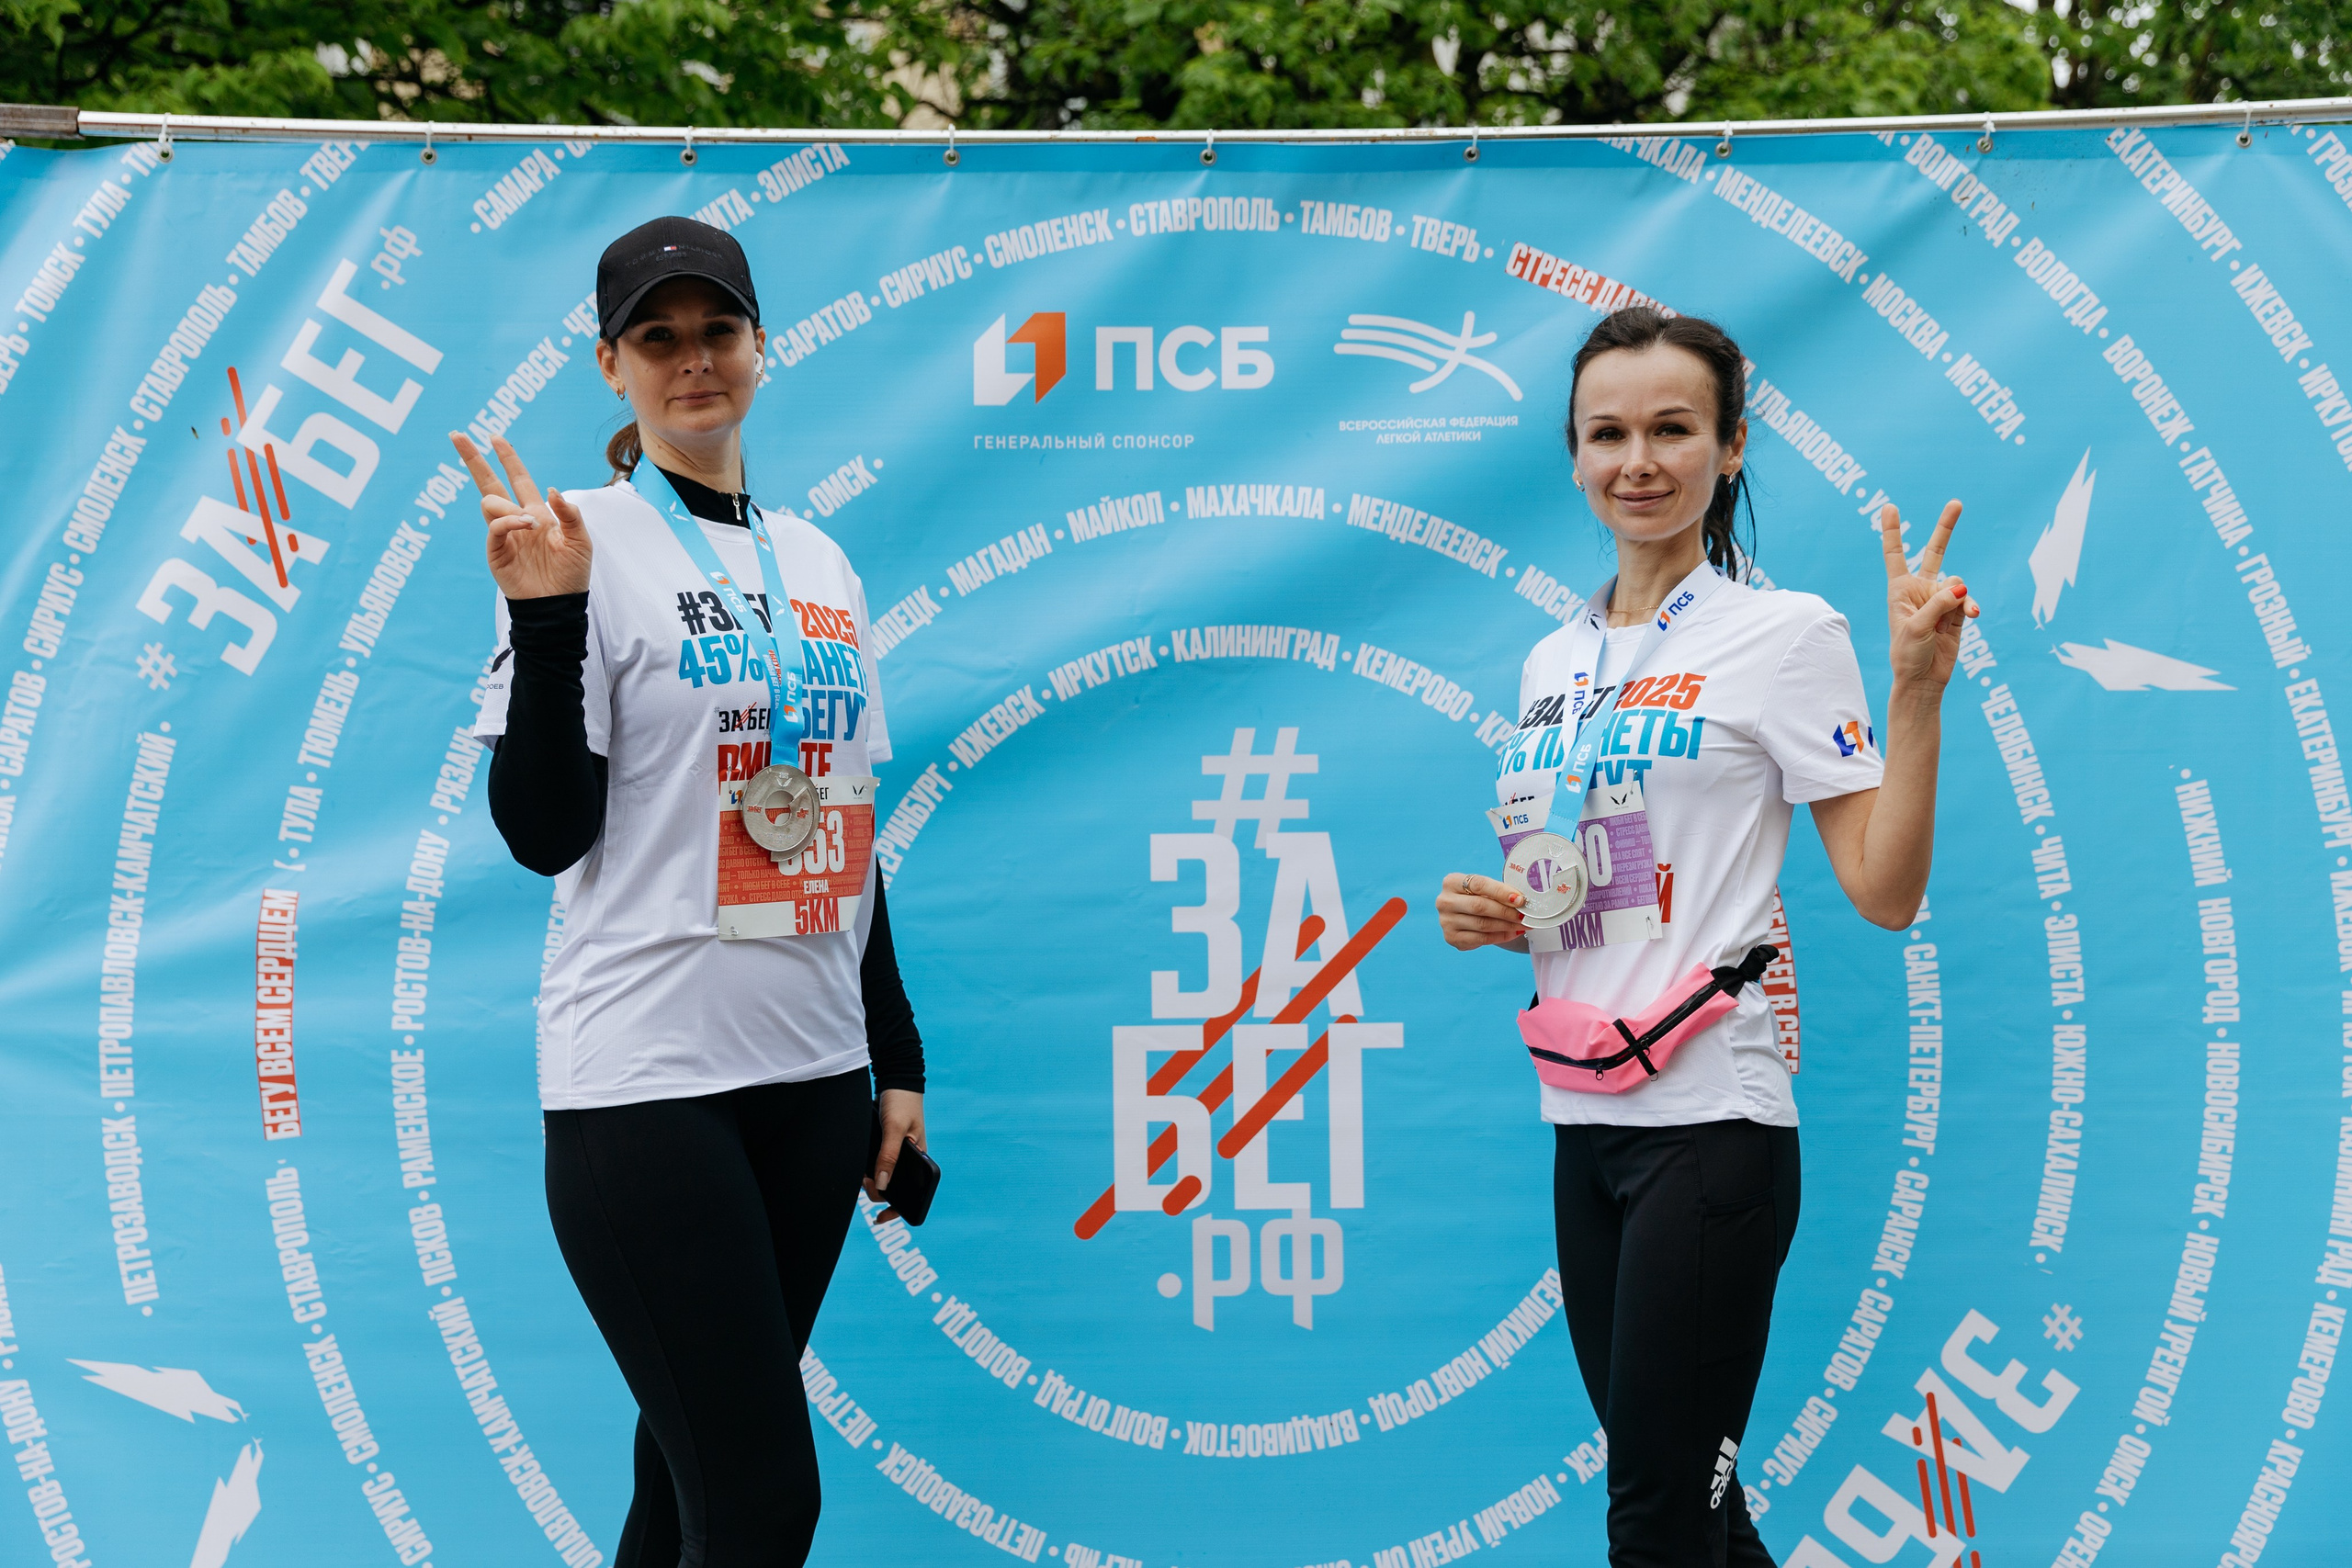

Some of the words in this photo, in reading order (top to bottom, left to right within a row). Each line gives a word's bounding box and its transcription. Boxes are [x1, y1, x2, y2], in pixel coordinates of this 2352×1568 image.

[472, 147, 561, 221] САМАРА
[757, 141, 851, 205] ЭЛИСТА
[14, 241, 86, 323] ТОМСК
[74, 173, 131, 239] ТУЛА
[225, 186, 308, 277] ТАМБОВ
[773, 291, 873, 367] САРАТОВ
[878, 245, 973, 309] СИРИУС
[984, 209, 1114, 268] СМОЛЕНСК
[1129, 197, 1280, 237] СТАВРОПОЛЬ
[1300, 200, 1392, 242] ТАМБОВ
[1410, 215, 1480, 263] ТВЕРЬ
[1506, 243, 1599, 304] СТРЕСС
[1713, 165, 1869, 284] МЕНДЕЛЕЕВСК
[1861, 273, 1950, 361] МОСКВА
[1944, 352, 2026, 442] МСТЁРА
[2230, 264, 2313, 364] ИЖЕВСК
[130, 282, 238, 423] СТАВРОПОЛЬ
[1095, 324, 1275, 392] ПСБ
[974, 432, 1105, 449] ГЕНЕРАЛЬНЫЙ
[1112, 434, 1194, 449] СПОНСОР
[1339, 417, 1446, 432] ВСЕРОССИЙСКАЯ
[1449, 415, 1519, 428] ФЕДЕРАЦИЯ
[1375, 431, 1421, 445] ЛЕГКОЙ
[1424, 431, 1482, 443] АТЛЕТИКИ
[1747, 379, 1866, 496] УЛЬЯНОВСК
[62, 426, 147, 554] СМОЛЕНСК
[414, 457, 470, 520] УФА
[807, 455, 872, 519] ОМСК
[23, 563, 85, 659] СИРИУС
[338, 520, 432, 659] УЛЬЯНОВСК
[724, 587, 747, 614] ПСБ
[874, 585, 942, 660] ИПЕЦК
[946, 523, 1054, 597] МАГАДАН
[1066, 489, 1165, 545] МАЙКОП
[1186, 484, 1326, 521] МАХАЧКАЛА
[1346, 493, 1510, 580] МЕНДЕЛЕЕВСК
[1668, 591, 1694, 618] ПСБ
[678, 634, 764, 689] 45%
[789, 599, 860, 650] 2025
[0, 670, 47, 777] САРАТОВ
[297, 670, 360, 769] ТЮМЕНЬ
[786, 671, 797, 703] ПСБ
[948, 684, 1046, 770] ИЖЕВСК
[1048, 636, 1159, 702] ИРКУТСК
[1170, 625, 1340, 673] КАЛИНИНГРАД
[1351, 642, 1476, 723] КЕМЕРОВО
[1572, 690, 1586, 716] ПСБ
[1613, 672, 1707, 711] 2025
[1572, 743, 1592, 773] ПСБ
[1904, 133, 2021, 248] ВОЛГОГРАД
[2013, 237, 2109, 335] ВОЛОГДА
[2102, 333, 2195, 447] ВОРОНЕЖ
[2178, 446, 2254, 549] ГАТЧИНА
[2235, 552, 2313, 670] ГРОЗНЫЙ
[2281, 1302, 2347, 1430] КЕМЕРОВО
[1980, 683, 2055, 825] ЧЕЛЯБИНСК
[278, 784, 323, 843] ТУЛА
[1513, 814, 1529, 826] ПСБ
[2175, 779, 2233, 887] НИЖНИЙ
[98, 731, 177, 1098] ПЕТРОПАВЛОВСК-КАМЧАТСКИЙ
[737, 870, 759, 880] ТОЛЬКО
[749, 892, 771, 902] СТРЕСС
[803, 879, 829, 894] ЕЛЕНА
[2031, 835, 2072, 900] ЧИТА
[257, 889, 299, 1004] СЕРДЦЕМ
[391, 829, 450, 1031] РОСТОВ-НА-ДОНУ
[795, 897, 840, 935] 5КМ
[1149, 831, 1364, 1019] ЗА
[2043, 913, 2086, 1007] ЭЛИСТА
[2197, 897, 2240, 1024] НОВГОРОД
[256, 1009, 293, 1075] ВСЕМ
[1902, 942, 1943, 1156] САНКТ-ПЕТЕРБУРГ
[260, 1078, 301, 1140] БЕГУ
[390, 1049, 435, 1189] РАМЕНСКОЕ
[1113, 1022, 1404, 1211] БЕГ
[2029, 1024, 2086, 1252] ЮЖНО-САХАЛИНСК
[2191, 1043, 2240, 1219] НОВОСИБИРСК
[102, 1114, 160, 1305] ПЕТРОЗАВОДСК
[266, 1167, 327, 1323] СТАВРОПОЛЬ
[409, 1203, 458, 1287] ПСКОВ
[1871, 1169, 1929, 1279] САРАНСК
[2167, 1232, 2221, 1323] НОВЫЙ
[933, 1294, 1032, 1389] ВОЛОГДА
[1368, 1340, 1492, 1432] НОВГОРОД
[1823, 1288, 1894, 1392] САРАТОВ
[2132, 1319, 2198, 1427] УРЕНГОЙ
[302, 1333, 379, 1464] СМОЛЕНСК
[1034, 1369, 1169, 1450] ВОЛГОГРАД
[1183, 1409, 1361, 1458] ВЛАДИВОСТОК
[1761, 1394, 1838, 1486] СИРИУС
[875, 1442, 1047, 1563] ПЕТРОЗАВОДСК
[1473, 1473, 1562, 1551] НОВЫЙ
[2094, 1433, 2152, 1507] ОМСК
[362, 1472, 433, 1567] СИРИУС
